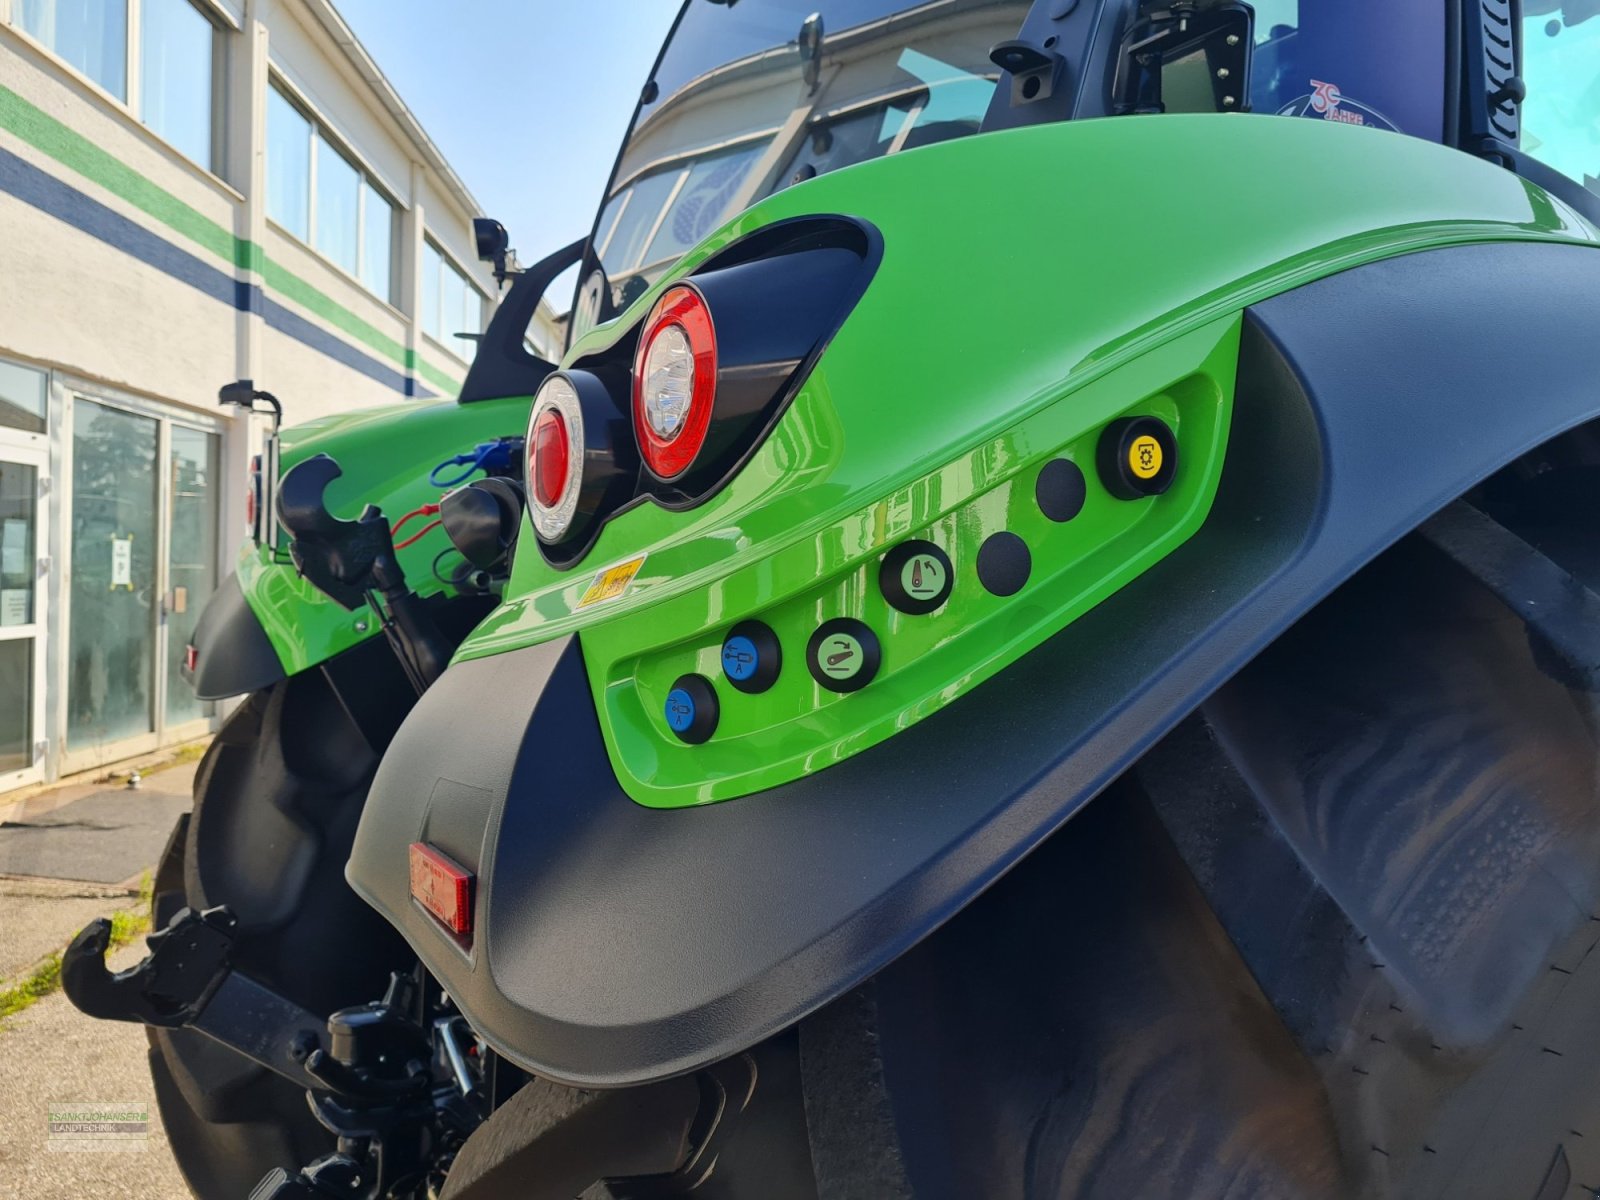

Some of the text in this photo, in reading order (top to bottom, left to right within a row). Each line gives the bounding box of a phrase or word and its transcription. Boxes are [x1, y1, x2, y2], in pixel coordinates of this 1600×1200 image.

[1310, 79, 1341, 113] 30
[1324, 107, 1364, 126] JAHRE
[735, 663, 743, 674] A
[675, 715, 682, 725] A
